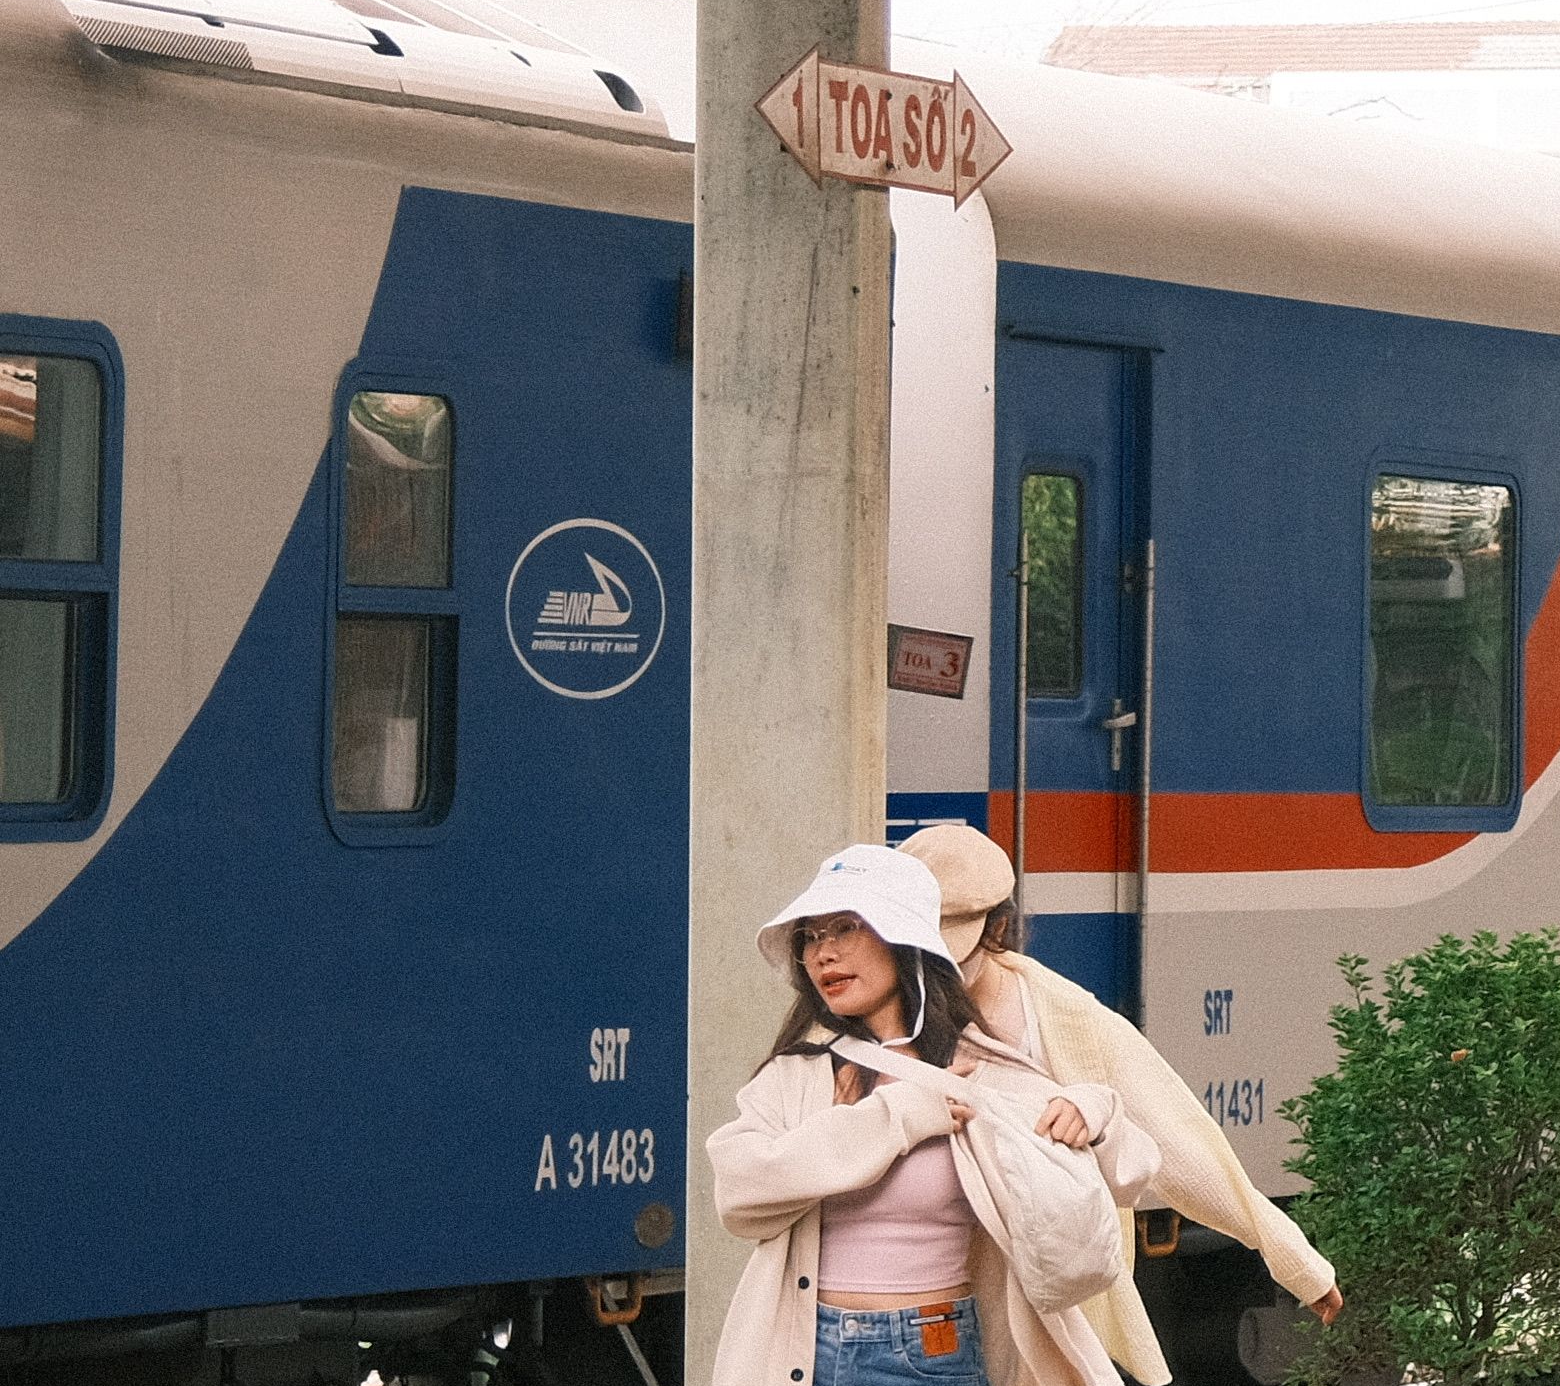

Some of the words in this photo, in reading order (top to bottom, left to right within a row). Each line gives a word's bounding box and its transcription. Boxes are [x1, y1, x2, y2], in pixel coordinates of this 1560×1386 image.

[792, 73, 803, 149] 1
[829, 81, 894, 163] TOA
[903, 85, 950, 173] SỐ
[961, 109, 976, 177] 2
[904, 650, 932, 670] TOA
[940, 652, 959, 677] 3
[1204, 989, 1233, 1036] SRT
[590, 1028, 630, 1082] SRT
[1204, 1078, 1264, 1128] 11431
[535, 1134, 557, 1191] A
[568, 1128, 655, 1188] 31483
